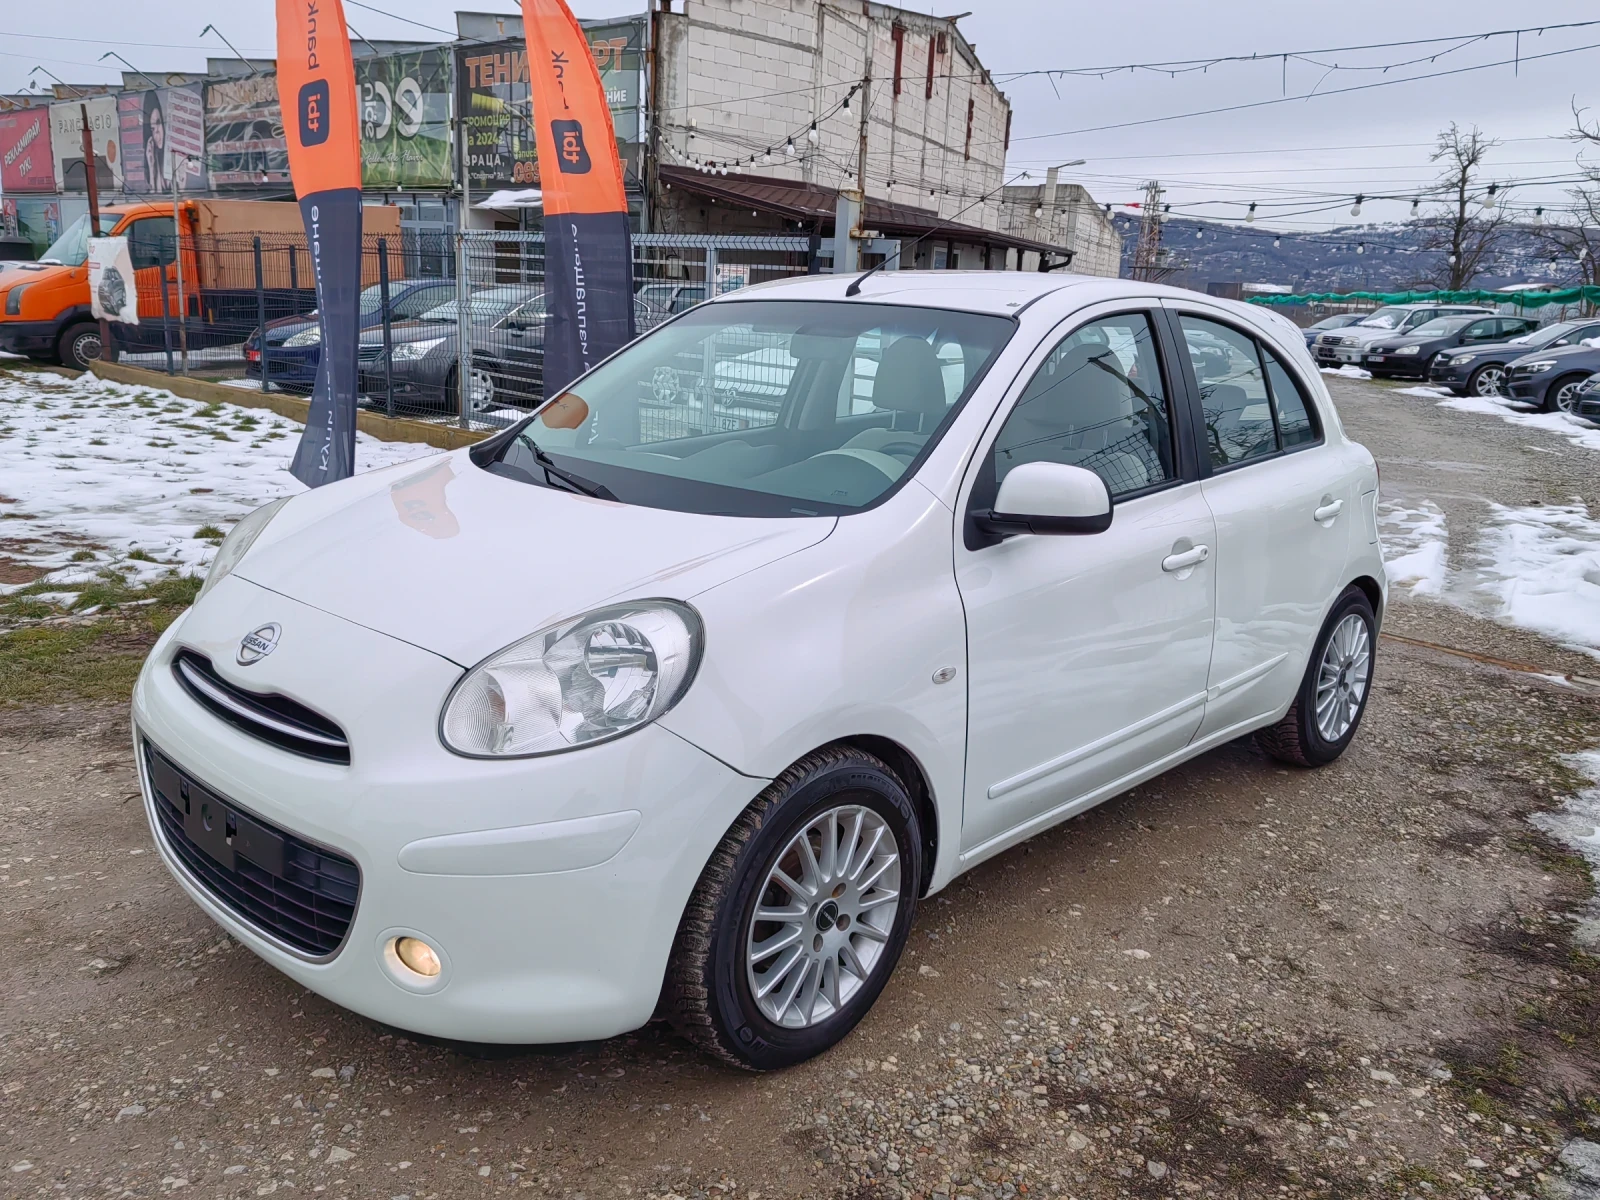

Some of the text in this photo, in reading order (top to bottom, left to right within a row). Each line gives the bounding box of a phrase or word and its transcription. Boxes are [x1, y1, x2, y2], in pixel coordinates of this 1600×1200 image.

[465, 50, 530, 88] ТЕНИ
[4, 118, 40, 167] РЕКЛАМИРАЙ
[19, 157, 32, 177] ТУК!
[243, 634, 270, 651] SSAN
